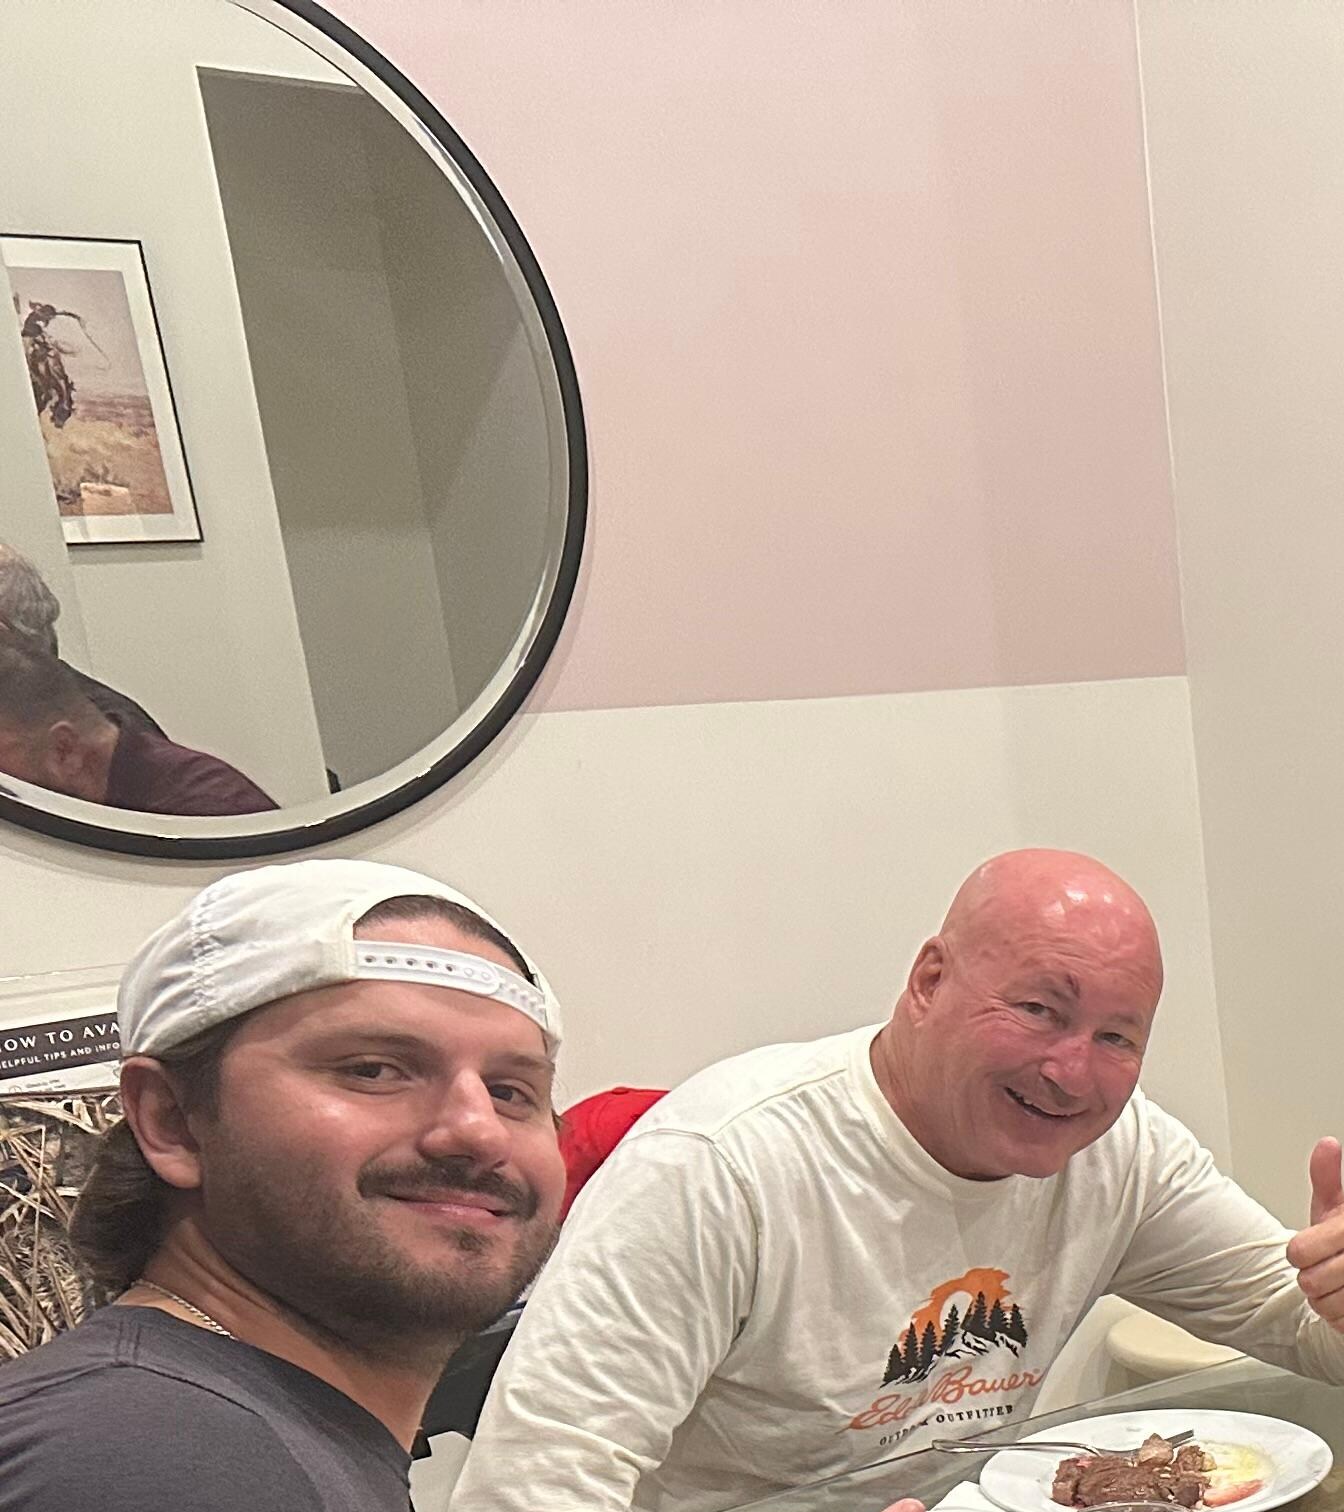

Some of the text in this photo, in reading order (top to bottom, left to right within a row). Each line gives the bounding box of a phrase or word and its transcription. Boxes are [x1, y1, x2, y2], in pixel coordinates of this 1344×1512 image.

[0, 1035, 37, 1054] OW
[44, 1029, 74, 1045] TO
[43, 1050, 68, 1062] TIPS
[70, 1045, 93, 1057] AND
